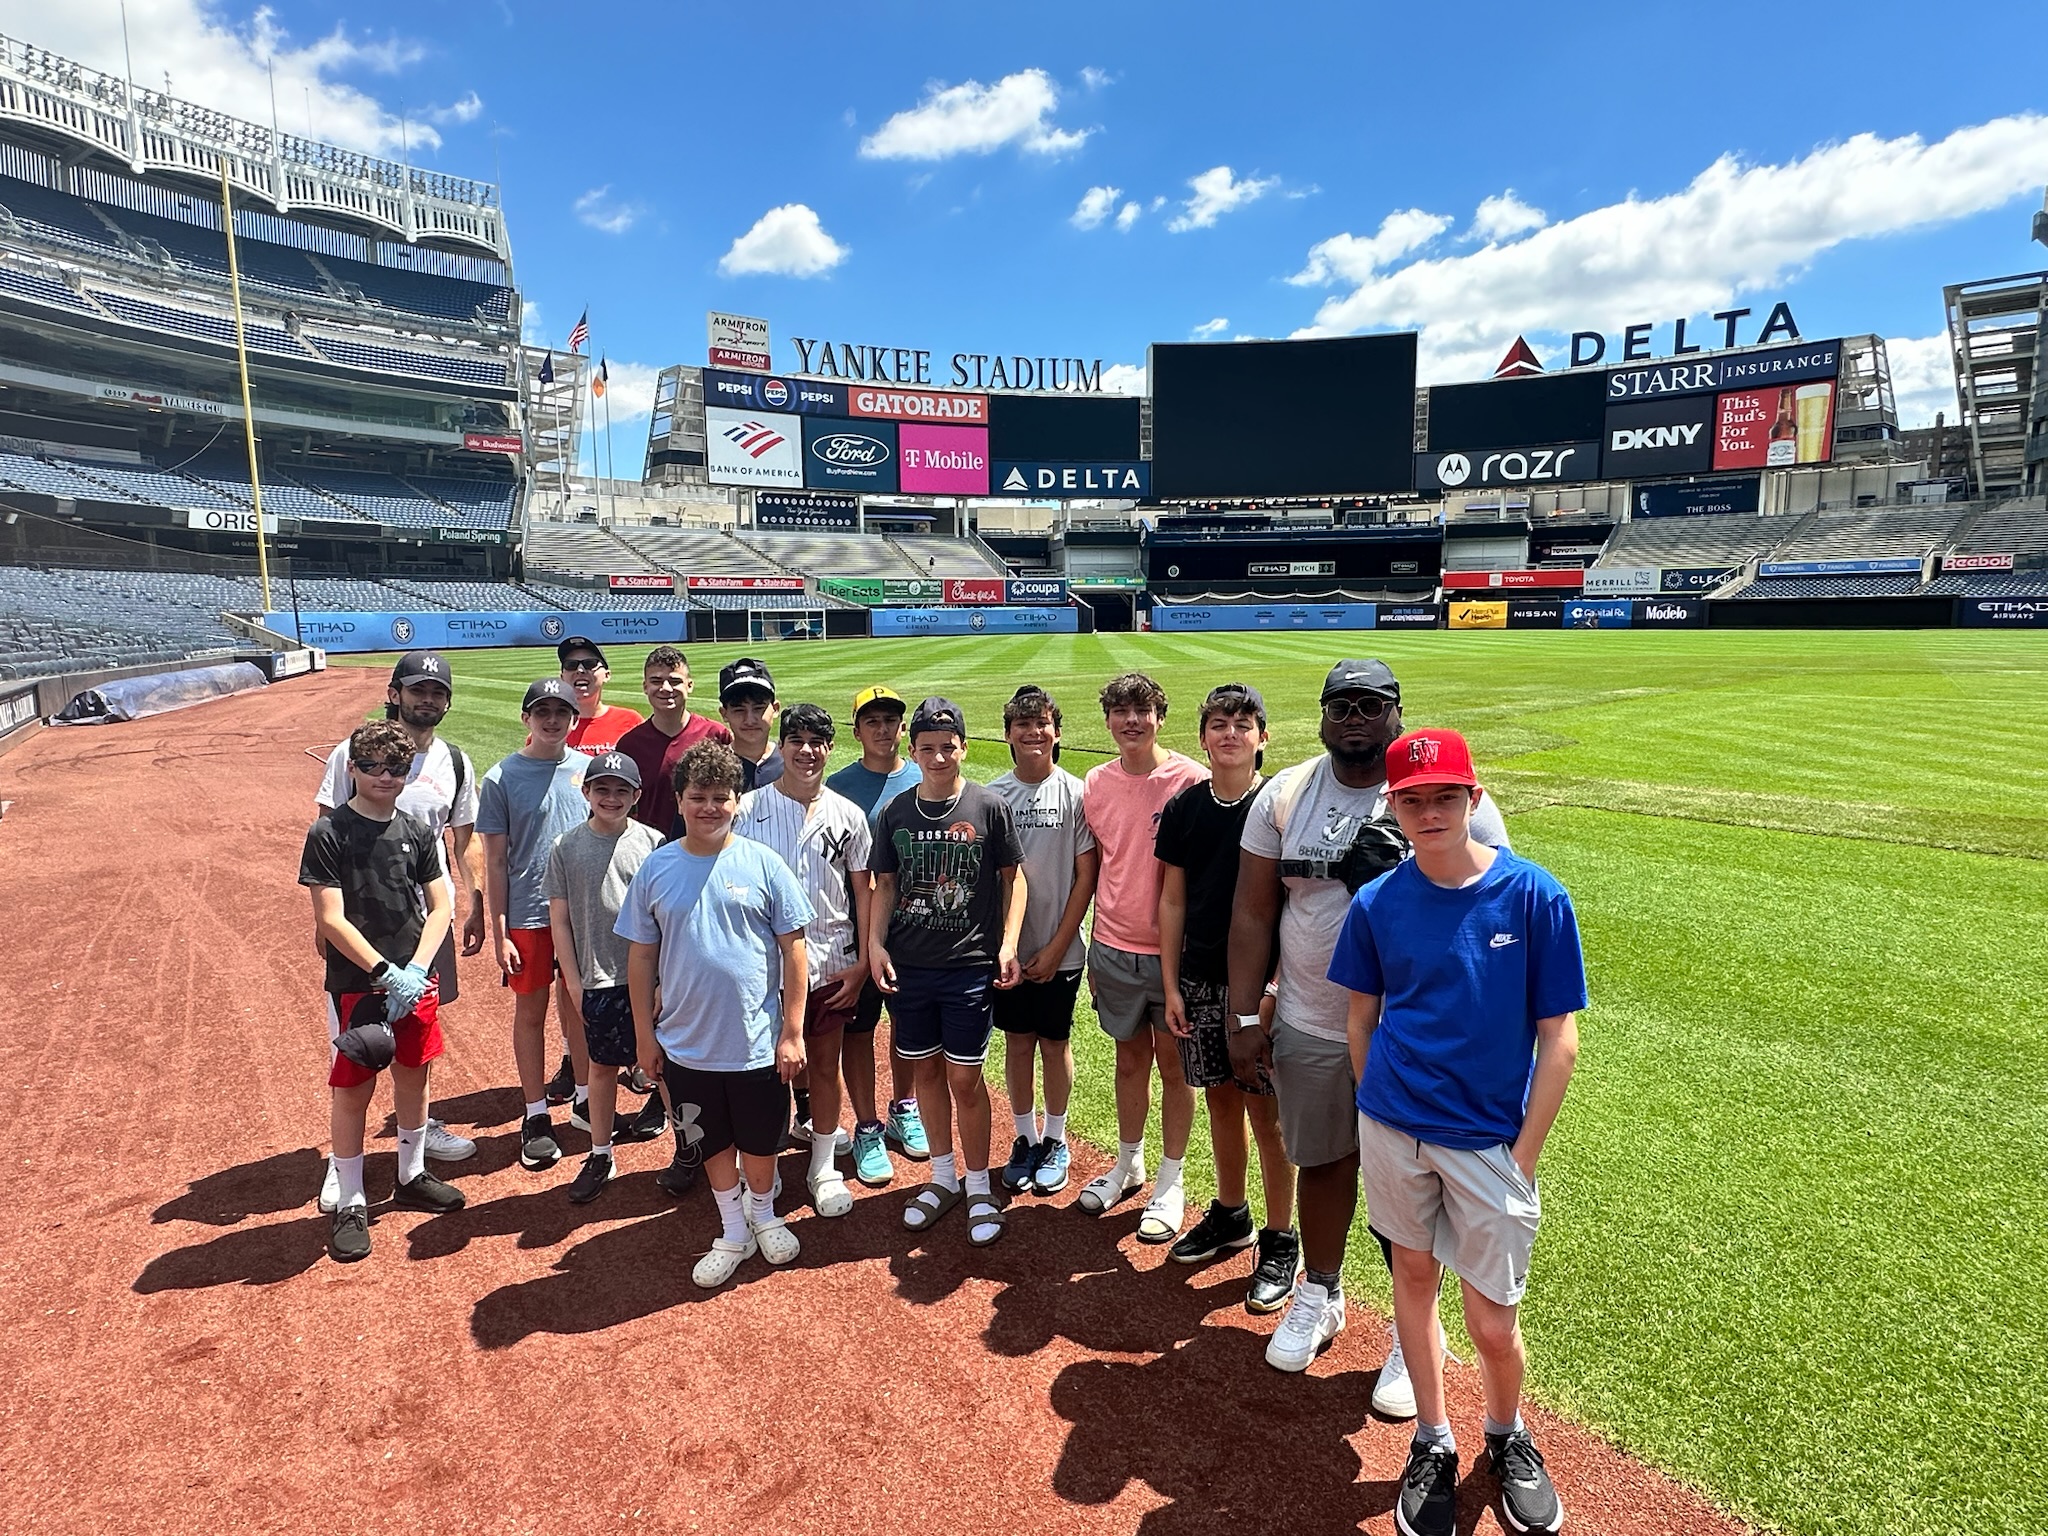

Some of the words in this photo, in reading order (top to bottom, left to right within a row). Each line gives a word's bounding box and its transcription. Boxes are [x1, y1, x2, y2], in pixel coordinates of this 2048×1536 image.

[713, 317, 767, 332] ARMITRON
[1570, 301, 1800, 368] DELTA
[717, 350, 765, 363] ARMITRON
[791, 337, 932, 384] YANKEE
[951, 354, 1104, 392] STADIUM
[1609, 363, 1716, 397] STARR
[1726, 352, 1834, 378] INSURANCE
[718, 382, 752, 395] PEPSI
[766, 389, 787, 397] PEPSI
[800, 391, 834, 404] PEPSI
[164, 397, 204, 412] YANKEES
[857, 393, 981, 418] GATORADE
[1722, 395, 1760, 411] This
[1721, 409, 1767, 425] Bud's
[1612, 423, 1703, 451] DKNY
[1720, 426, 1748, 439] For
[483, 440, 521, 450] Budweiser
[826, 437, 876, 463] Ford
[1719, 439, 1755, 451] You.
[924, 450, 984, 471] Mobile
[1481, 448, 1576, 482] razr
[710, 465, 738, 474] BANK
[741, 467, 754, 475] OF
[755, 468, 800, 478] AMERICA
[1038, 469, 1140, 489] DELTA
[1707, 504, 1732, 512] BOSS
[206, 512, 258, 530] ORIS
[440, 529, 470, 540] Poland
[471, 530, 501, 543] Spring
[1944, 557, 2012, 568] Reebok
[1026, 582, 1059, 596] coupa
[1586, 579, 1631, 587] MERRILL
[823, 585, 850, 597] Uber
[852, 585, 880, 597] Eats
[1514, 610, 1557, 618] NISSAN
[1584, 608, 1614, 617] Caital
[1646, 605, 1687, 620] Modelo
[1978, 602, 2048, 612] ETIHAD
[601, 617, 659, 627] ETIHAD
[896, 614, 939, 623] ETIHAD
[1014, 613, 1058, 621] ETIHAD
[299, 622, 355, 633] ETIHAD
[448, 619, 507, 630] ETIHAD
[310, 636, 344, 644] AIRWAYS
[422, 656, 439, 673] NY
[543, 679, 561, 694] NY
[604, 754, 622, 770] NY
[918, 830, 968, 842] BOSTON
[819, 828, 851, 863] NY
[1298, 845, 1333, 860] BENCH
[891, 828, 983, 897] CELTICS
[1493, 933, 1513, 942] NIKE
